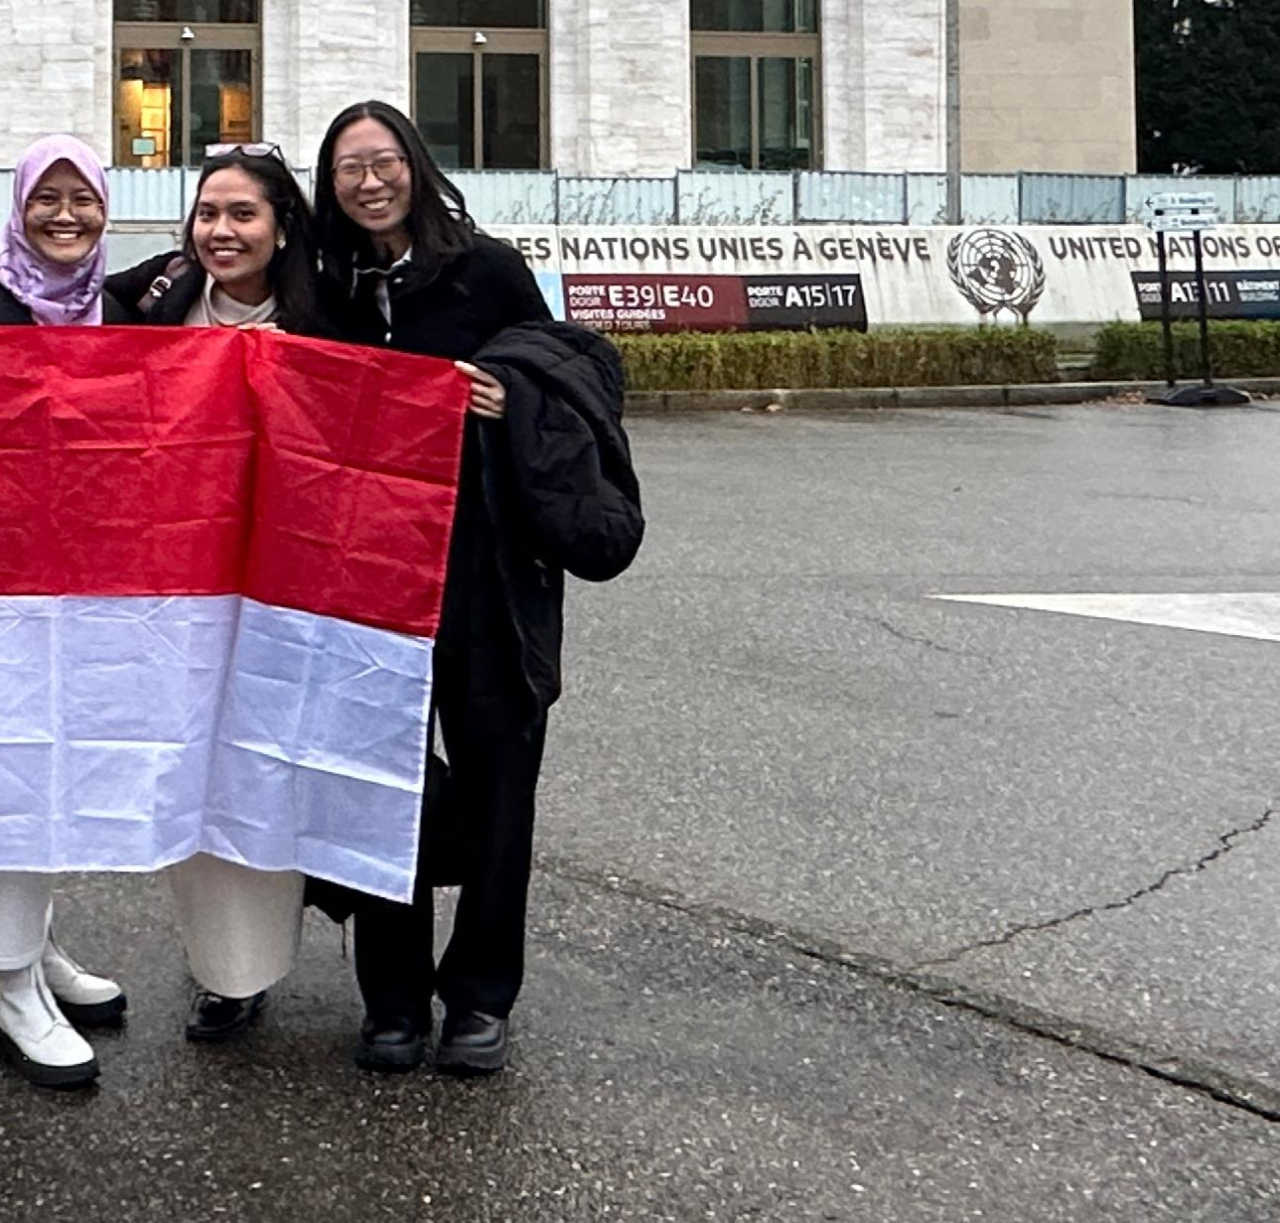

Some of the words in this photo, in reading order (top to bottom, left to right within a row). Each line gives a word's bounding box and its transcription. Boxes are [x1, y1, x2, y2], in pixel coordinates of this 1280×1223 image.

[561, 237, 690, 261] NATIONS
[697, 236, 784, 262] UNIES
[792, 232, 813, 261] À
[819, 232, 930, 263] GENÈVE
[1049, 236, 1143, 260] UNITED
[1147, 236, 1251, 260] NATONS
[568, 285, 606, 296] PORTE
[746, 286, 784, 296] PORTE
[570, 296, 601, 307] DOOR
[570, 309, 614, 320] VISITES
